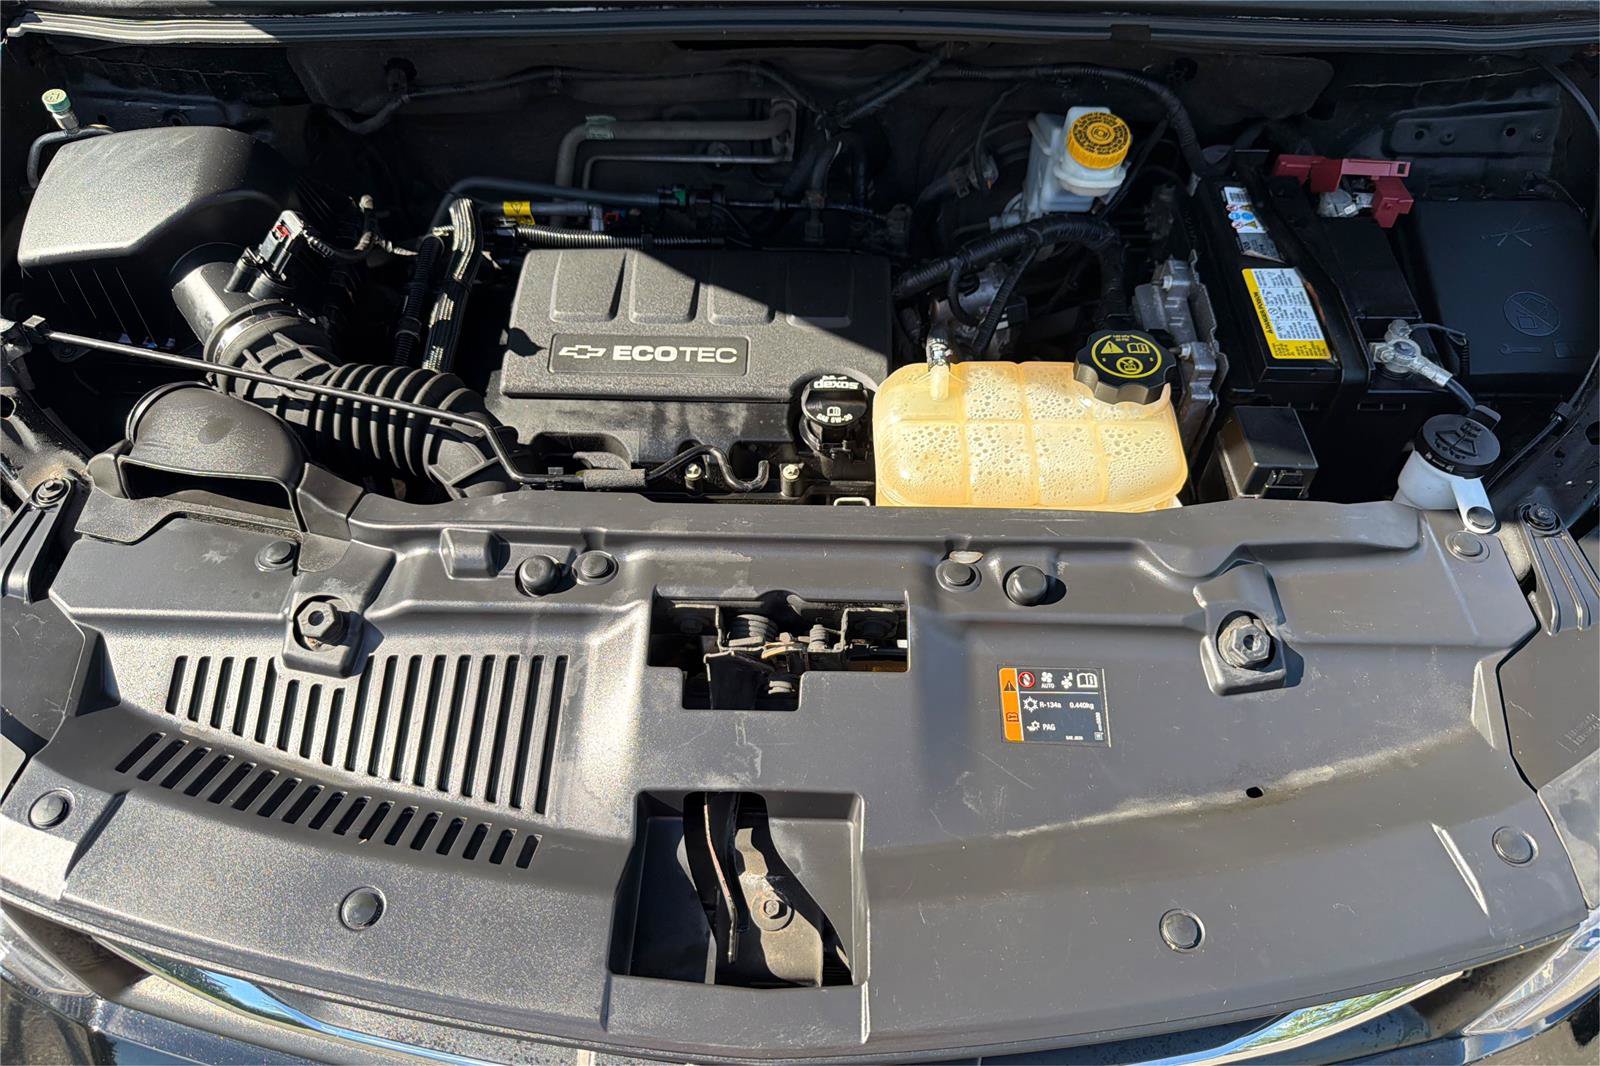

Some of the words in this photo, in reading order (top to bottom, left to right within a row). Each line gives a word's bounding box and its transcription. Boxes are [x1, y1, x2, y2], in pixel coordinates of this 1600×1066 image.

[612, 345, 738, 363] ECOTEC
[814, 380, 859, 389] dexos
[1039, 701, 1062, 709] R-134a
[1042, 723, 1056, 731] PAG
